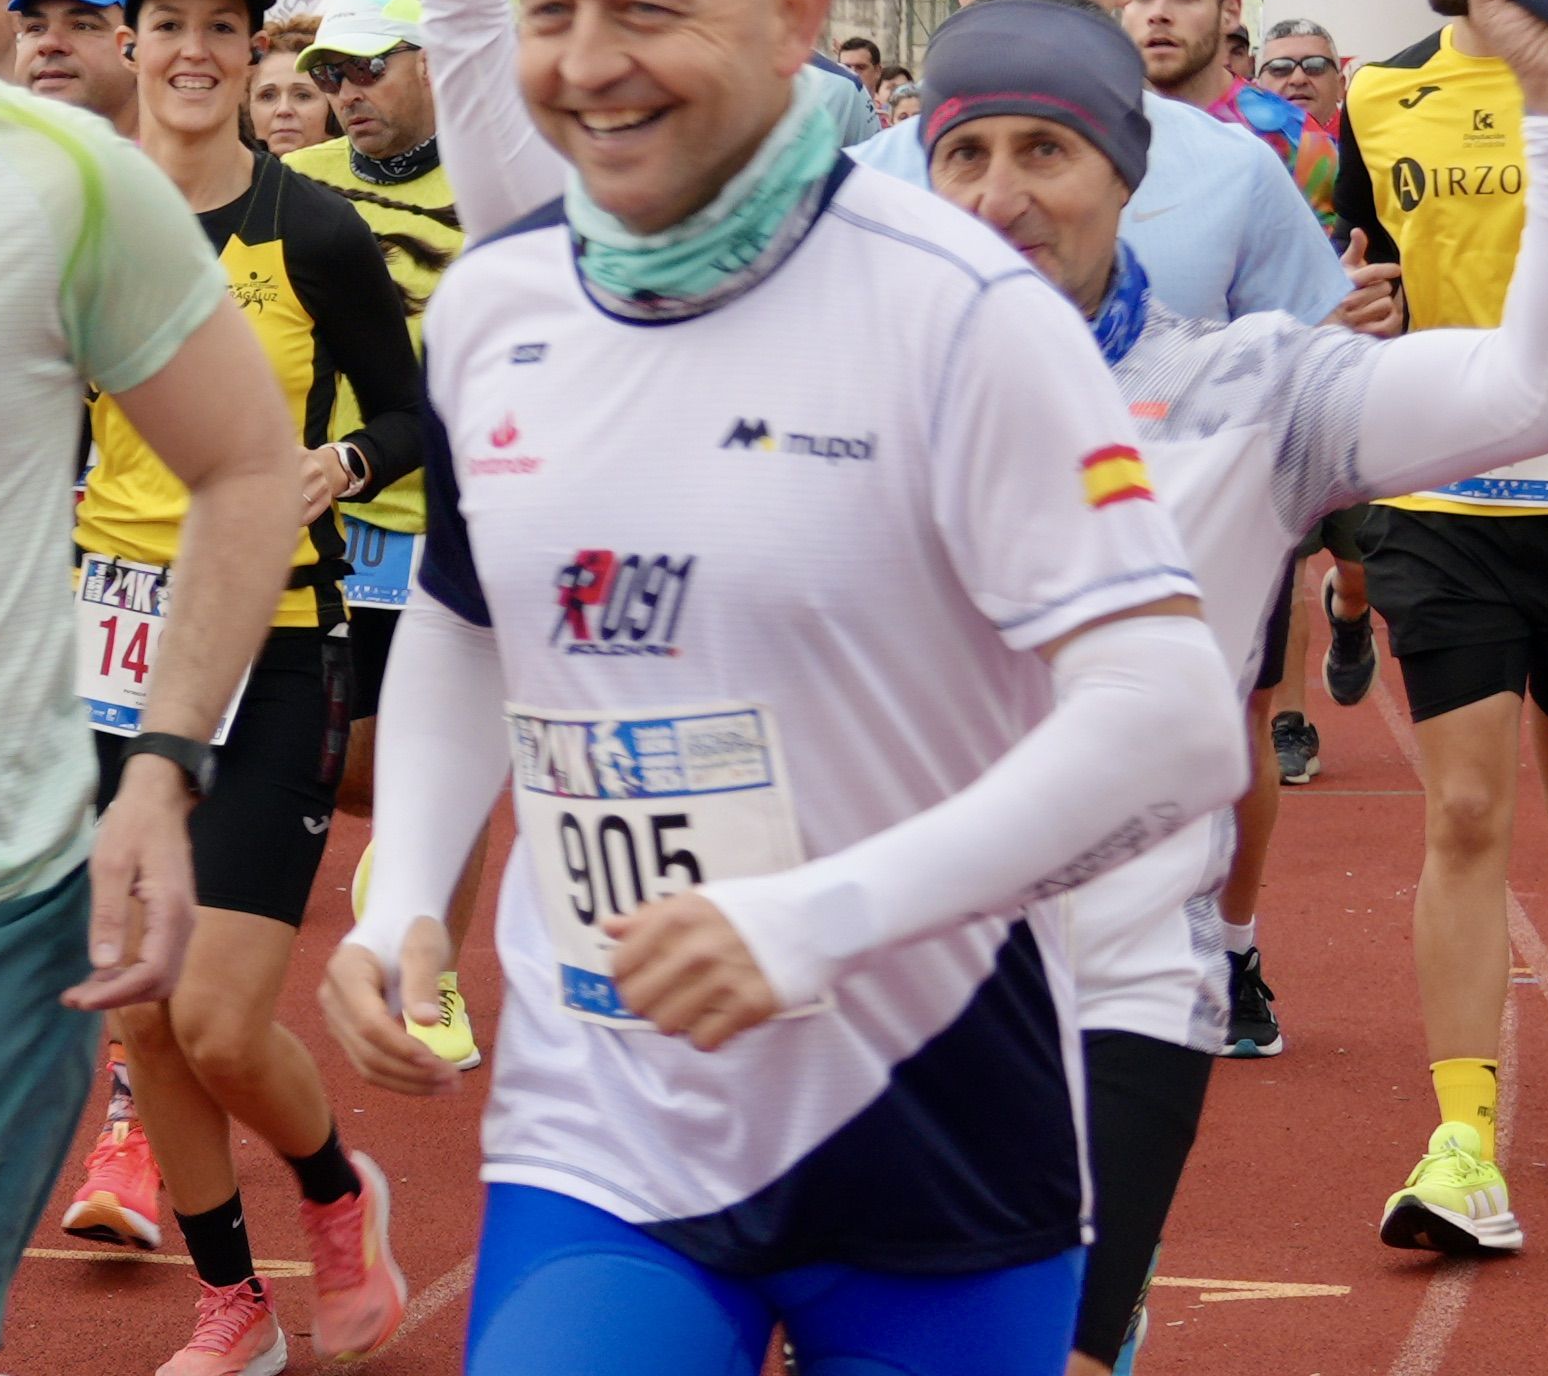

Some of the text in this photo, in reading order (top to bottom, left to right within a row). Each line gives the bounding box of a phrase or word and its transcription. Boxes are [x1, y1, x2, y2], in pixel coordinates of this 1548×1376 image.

[1396, 161, 1523, 203] AIRZO
[99, 615, 164, 684] 14
[559, 810, 703, 927] 905
